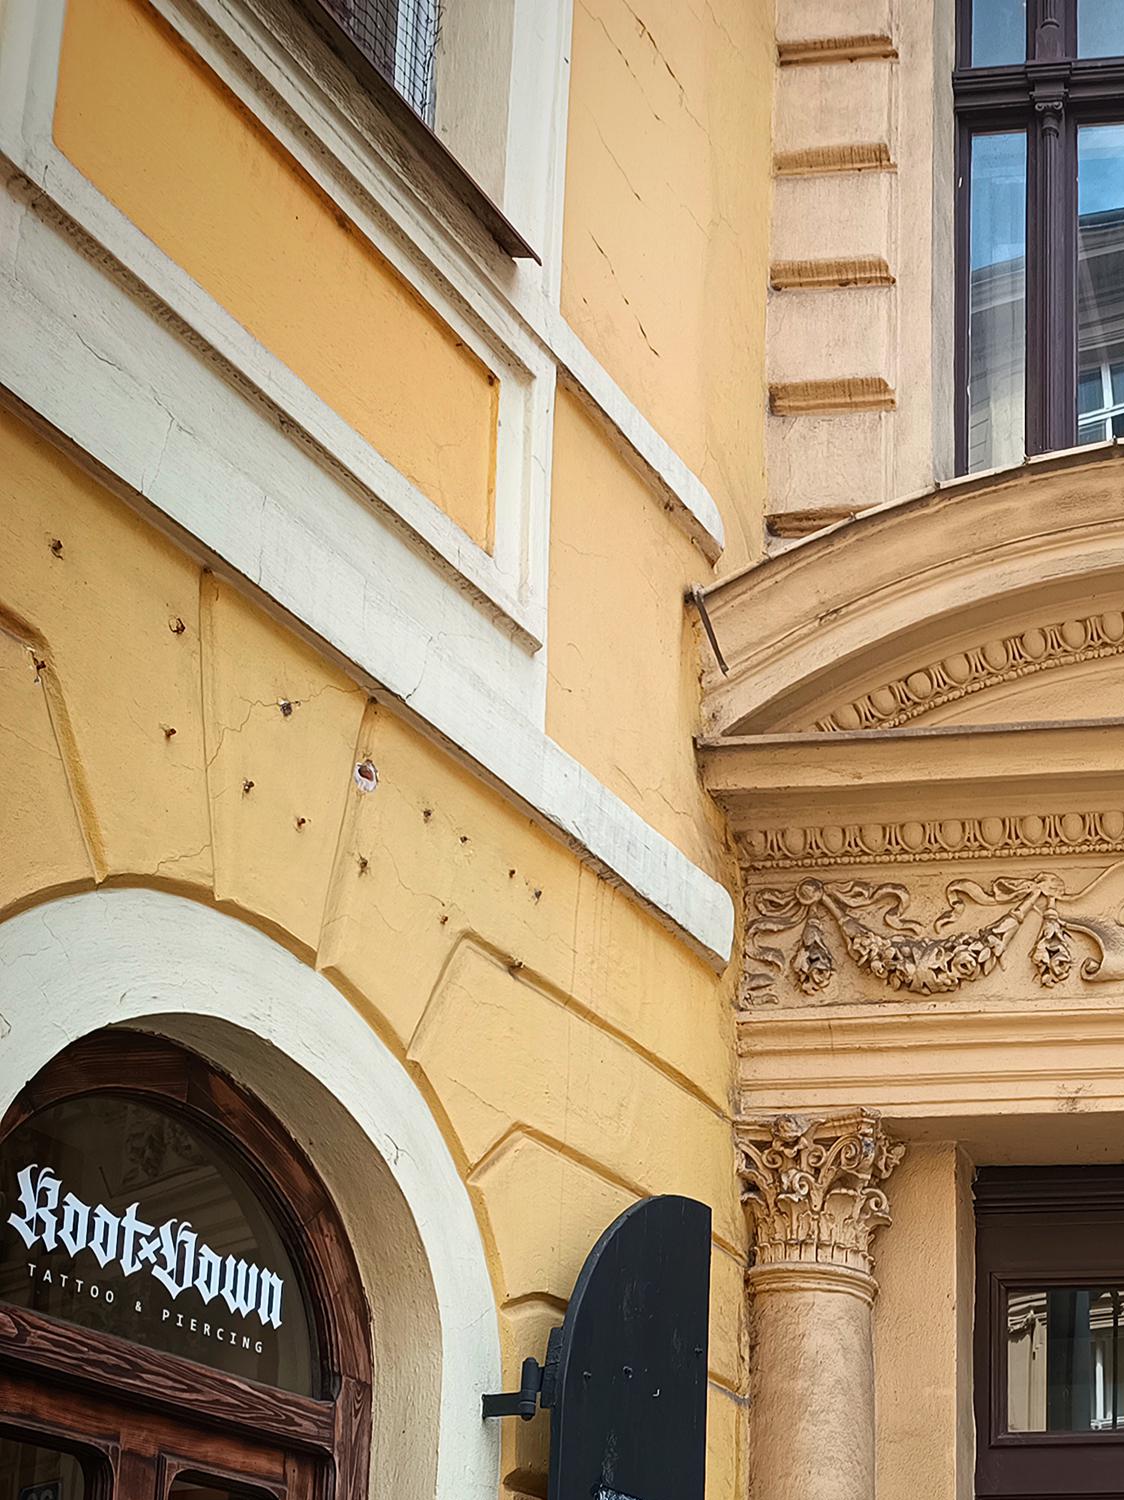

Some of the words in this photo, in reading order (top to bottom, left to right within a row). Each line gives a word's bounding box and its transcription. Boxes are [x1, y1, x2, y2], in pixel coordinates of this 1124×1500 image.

[27, 1263, 115, 1304] TATTOO
[135, 1300, 142, 1312] &
[162, 1308, 264, 1353] PIERCING
